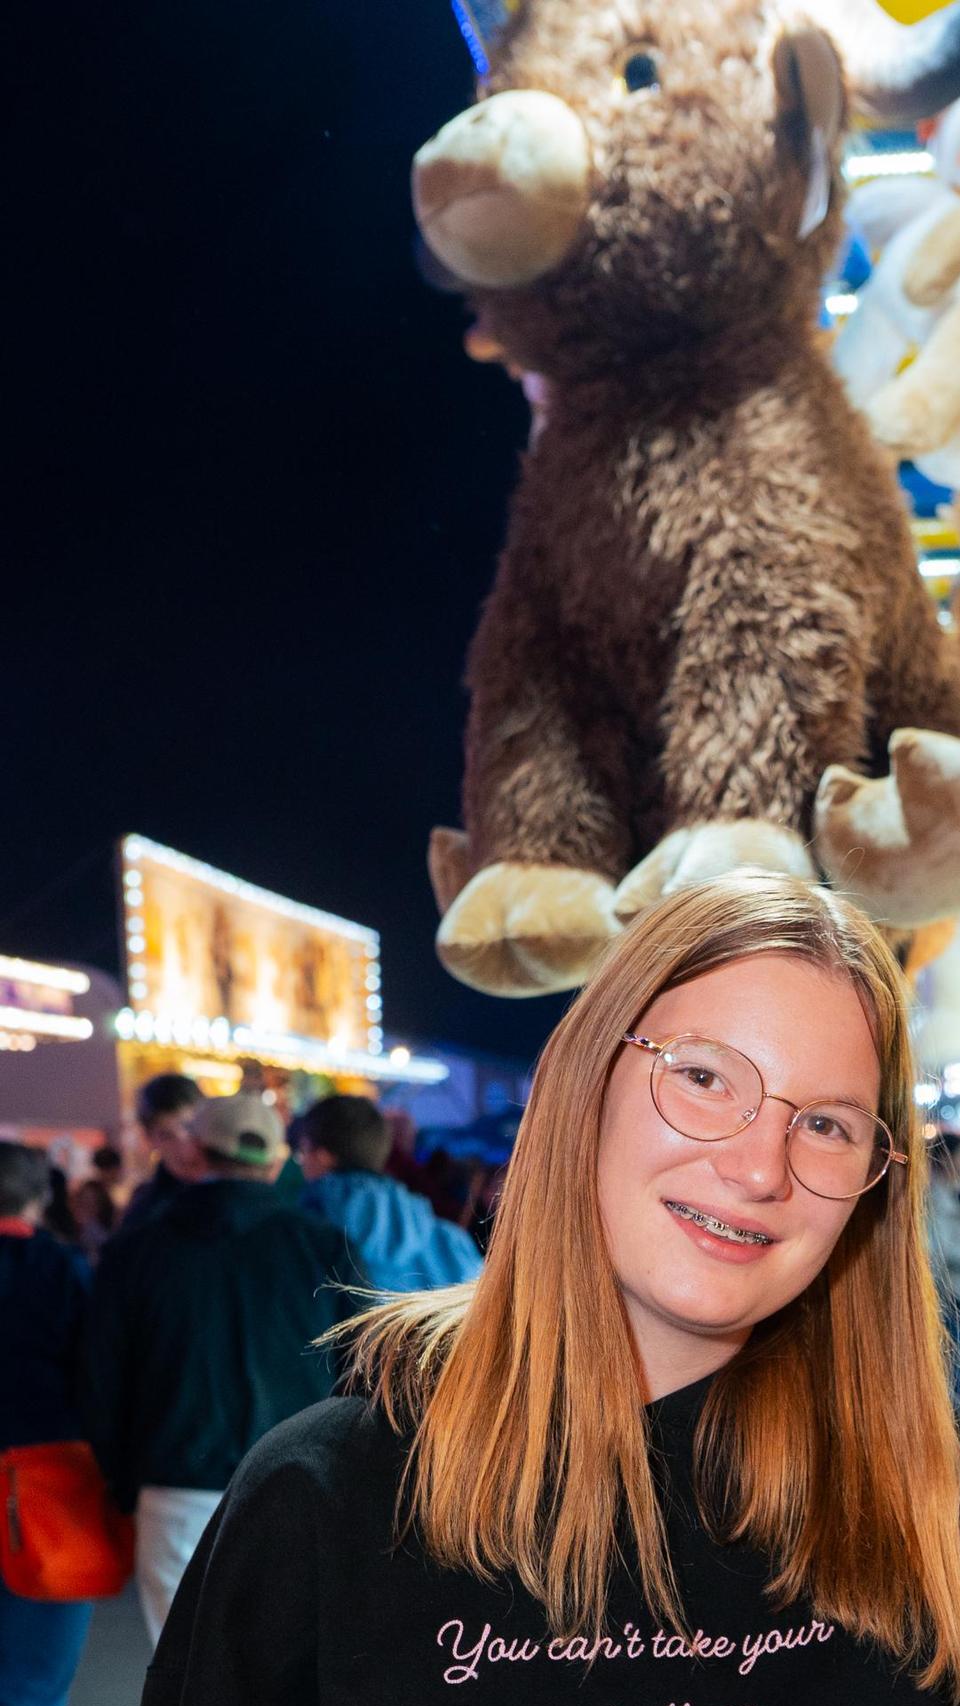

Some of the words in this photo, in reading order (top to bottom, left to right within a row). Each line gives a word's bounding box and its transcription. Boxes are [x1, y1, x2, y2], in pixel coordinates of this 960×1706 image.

[436, 1619, 540, 1685] You
[547, 1622, 645, 1664] can't
[651, 1629, 737, 1659] take
[738, 1619, 835, 1676] your
